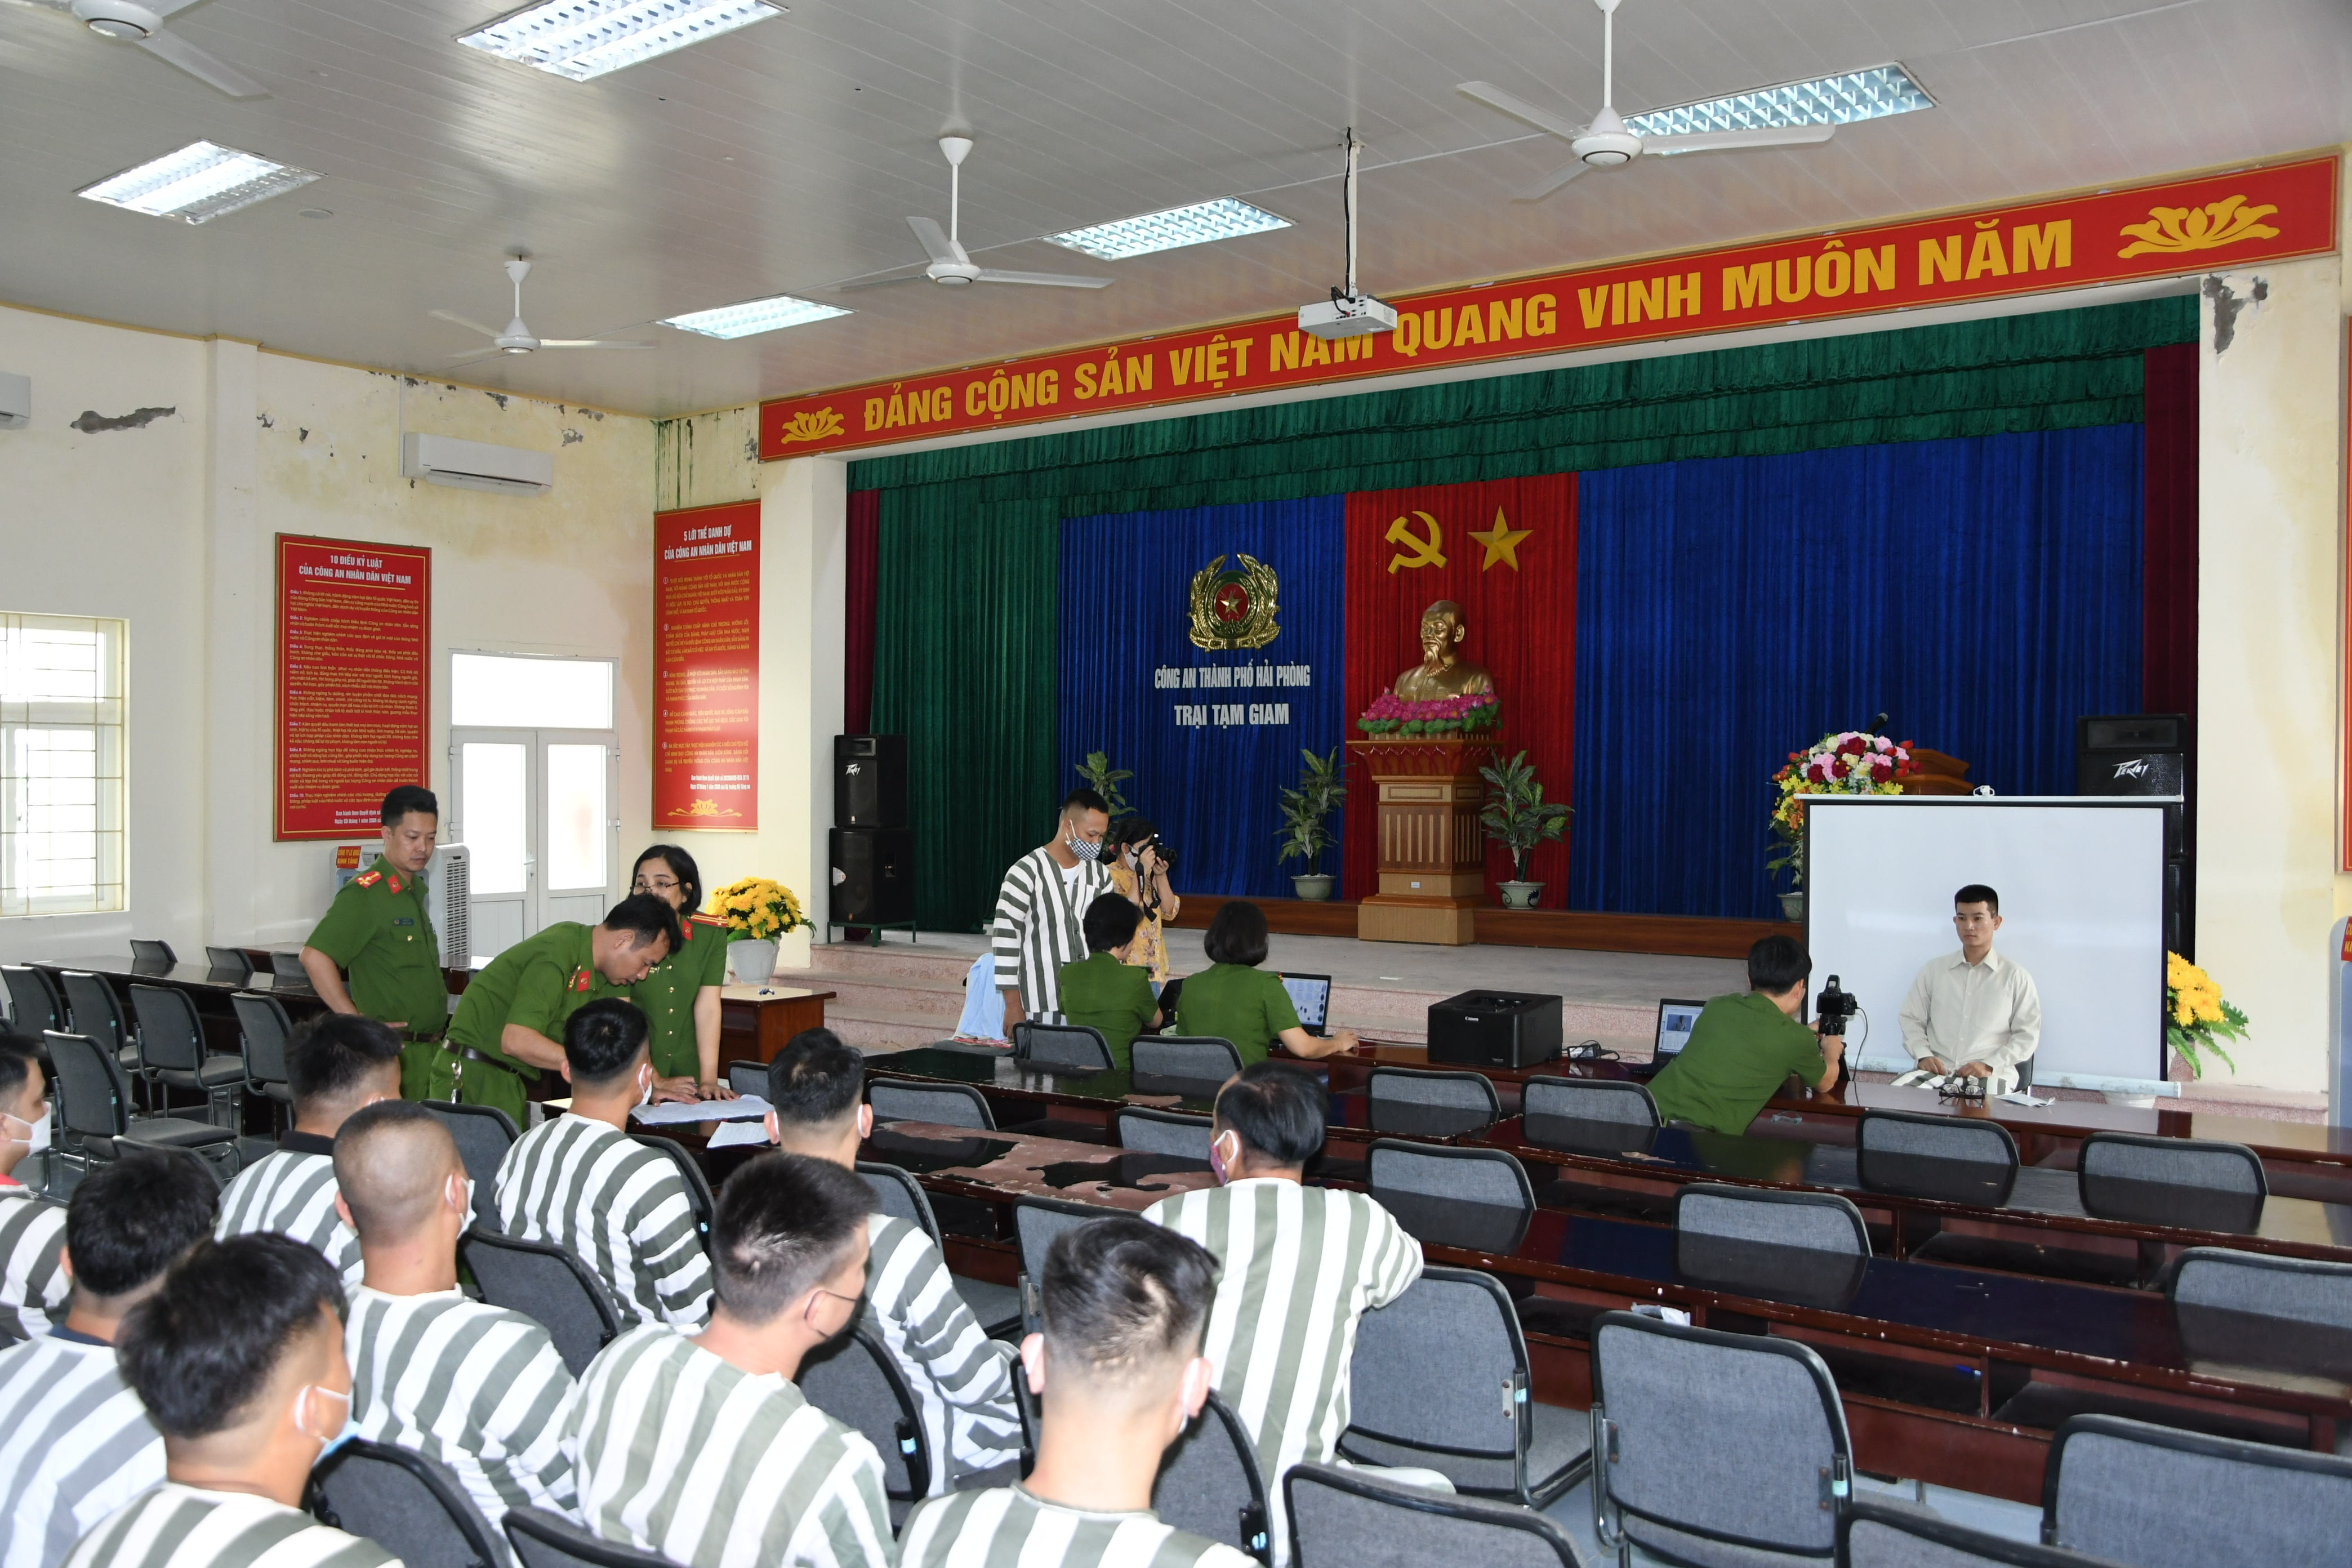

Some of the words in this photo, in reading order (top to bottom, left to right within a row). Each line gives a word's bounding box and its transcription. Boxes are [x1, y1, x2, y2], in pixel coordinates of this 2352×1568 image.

[863, 382, 952, 432] ĐẢNG
[965, 369, 1059, 421] CỘNG
[1074, 347, 1153, 400] SẢN
[1169, 334, 1253, 389] VIỆT
[1392, 293, 1557, 357] QUANG
[1578, 272, 1701, 329] VINH
[1722, 239, 1896, 311] MUÔN
[1918, 219, 2072, 286] NĂM
[684, 531, 688, 541] 5
[708, 527, 722, 538] DANH
[724, 524, 732, 538] DỰ
[664, 545, 674, 560] CỦA
[676, 546, 689, 558] CÔNG
[691, 546, 698, 557] AN
[699, 543, 713, 556] NHÂN
[715, 542, 726, 554] DÂN
[727, 540, 738, 554] VIỆT
[739, 540, 752, 551] NAM
[330, 555, 338, 564] 10
[357, 555, 365, 566] KỶ
[367, 558, 382, 570] LUẬT
[299, 563, 313, 575] CỦA
[315, 566, 333, 577] CÔNG
[335, 569, 344, 578] AN
[346, 570, 364, 580] NHÂN
[366, 571, 379, 581] DÂN
[381, 572, 395, 584] VIỆT
[396, 576, 411, 584] NAM
[1155, 665, 1180, 688] CÔNG
[1182, 668, 1196, 688] AN
[1199, 663, 1231, 687] THÀNH
[1234, 658, 1254, 687] PHỐ
[1256, 659, 1273, 687] HẢI
[1276, 661, 1310, 686] PHÒNG
[1174, 705, 1207, 729] TRẠI
[1212, 704, 1244, 729] TẠM
[1249, 704, 1289, 724] GIAM
